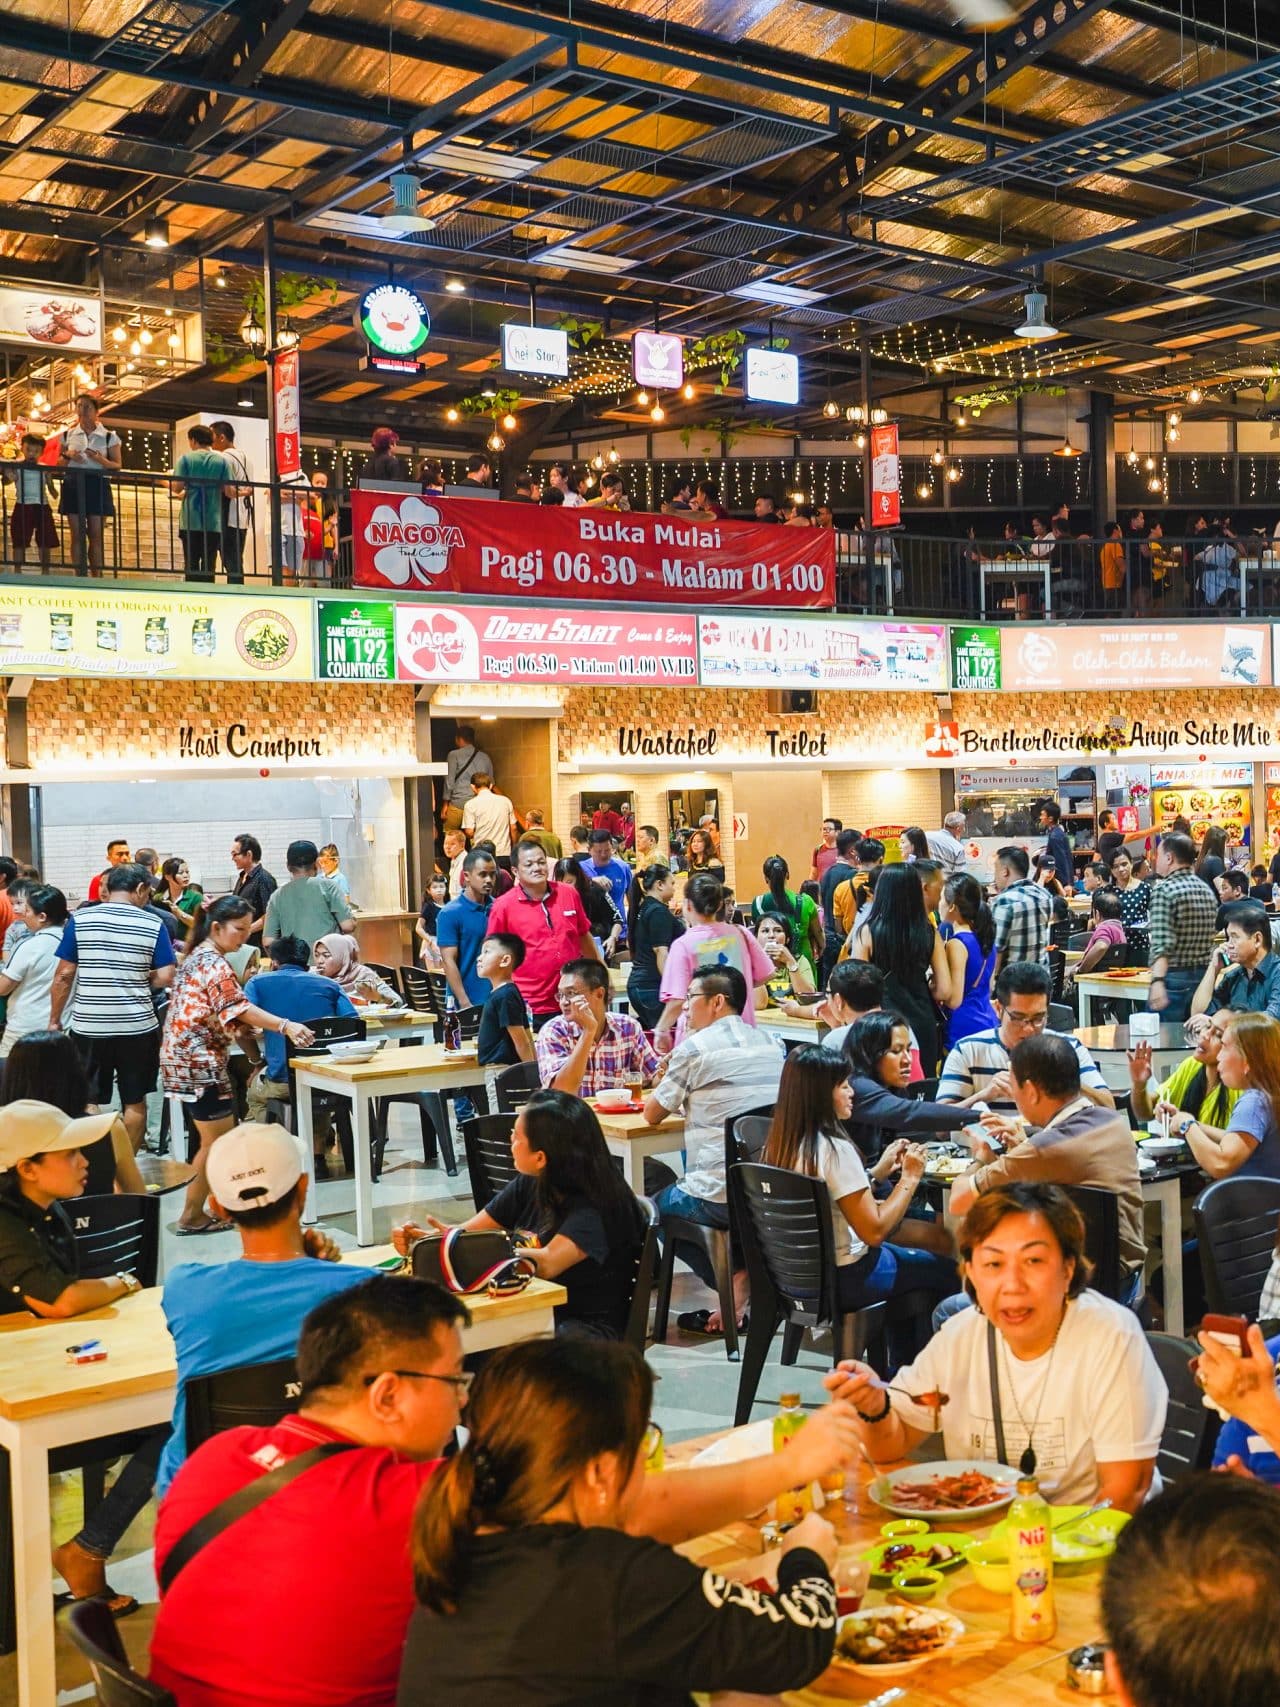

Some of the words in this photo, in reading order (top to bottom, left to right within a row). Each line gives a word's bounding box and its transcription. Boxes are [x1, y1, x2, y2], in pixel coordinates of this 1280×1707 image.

[369, 521, 466, 549] NAGOYA
[579, 518, 645, 546] Buka
[655, 523, 722, 549] Mulai
[397, 546, 417, 558] Food
[418, 548, 448, 559] Court
[481, 546, 545, 588] Pagi
[553, 552, 638, 586] 06.30
[662, 558, 744, 590] Malam
[751, 562, 825, 592] 01.00
[78, 599, 112, 611] WITH
[114, 601, 173, 615] ORIGINAL
[326, 625, 346, 637] SAME
[483, 615, 548, 641] OPEN
[549, 617, 623, 645] START
[627, 628, 653, 643] Come
[653, 628, 663, 642] &
[665, 628, 693, 646] Enjoy
[327, 637, 346, 662] IN
[353, 638, 388, 663] 192
[327, 661, 388, 679] COUNTRIES
[484, 656, 514, 676] Pagi
[516, 653, 558, 675] 06.30
[571, 658, 615, 675] Malam
[617, 655, 656, 676] 01.00
[660, 657, 695, 677] WIB
[956, 656, 970, 677] IN
[974, 656, 996, 677] 192
[957, 676, 998, 689] COUNTRIES
[179, 726, 220, 759] Nasi
[226, 723, 322, 764] Campur
[618, 726, 719, 760] Wastafel
[765, 730, 829, 757] Toilet
[1129, 721, 1181, 752] Anya
[1183, 720, 1230, 747] Sate
[1232, 722, 1271, 748] Mie
[972, 775, 1041, 785] brotherlicious
[1221, 768, 1247, 779] MIE
[75, 1216, 91, 1230] N
[1019, 1525, 1046, 1546] Nü
